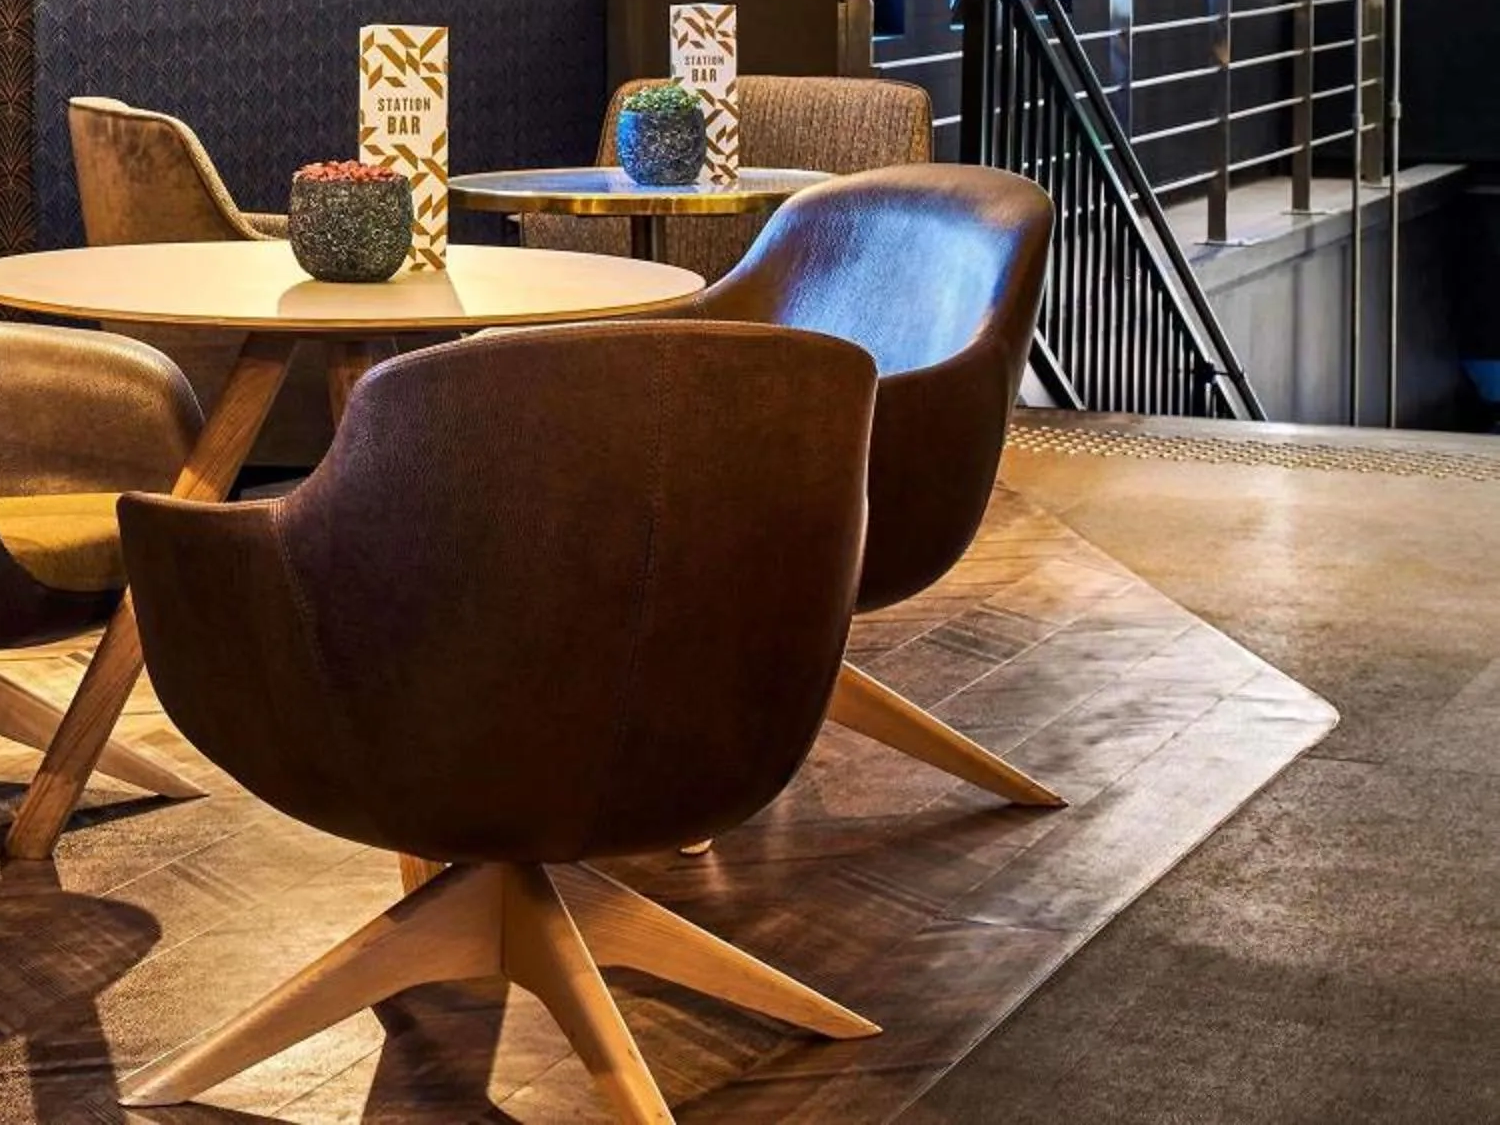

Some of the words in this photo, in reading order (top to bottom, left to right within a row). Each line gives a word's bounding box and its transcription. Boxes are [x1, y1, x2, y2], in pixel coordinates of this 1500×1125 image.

[684, 55, 725, 66] STATION
[691, 68, 717, 83] BAR
[377, 97, 431, 112] STATION
[387, 116, 421, 135] BAR
